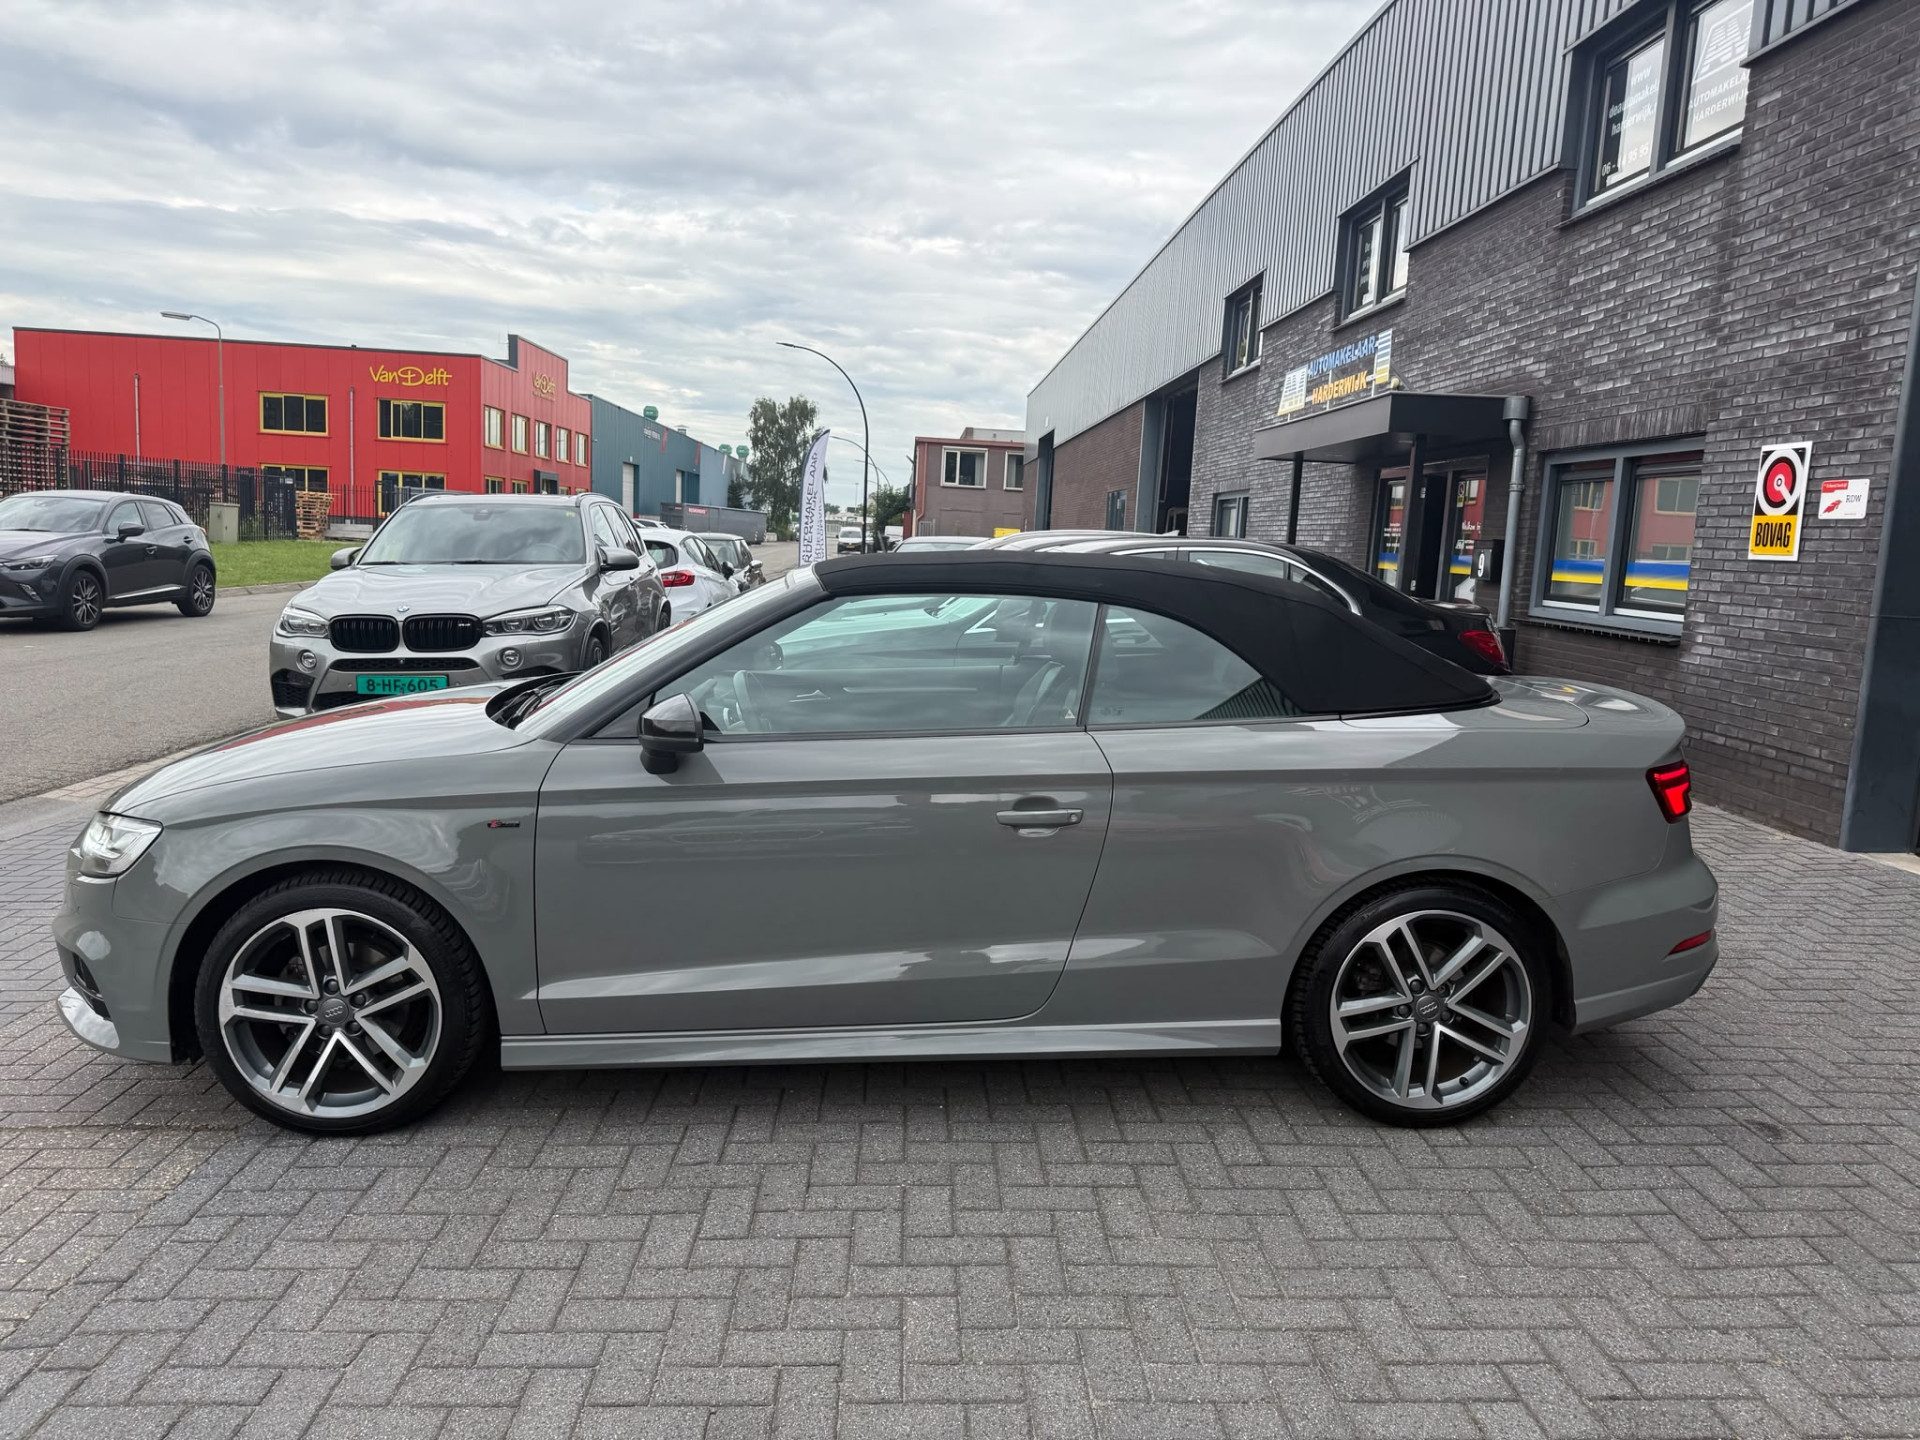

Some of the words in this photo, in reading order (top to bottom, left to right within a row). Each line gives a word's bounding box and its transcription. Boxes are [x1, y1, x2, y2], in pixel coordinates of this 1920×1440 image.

[1307, 335, 1376, 378] AUTOMAKELAAR
[1312, 370, 1368, 405] HARDERWIJK
[1845, 494, 1862, 504] RDW
[1755, 522, 1791, 548] BOVAG
[1477, 553, 1485, 577] 9
